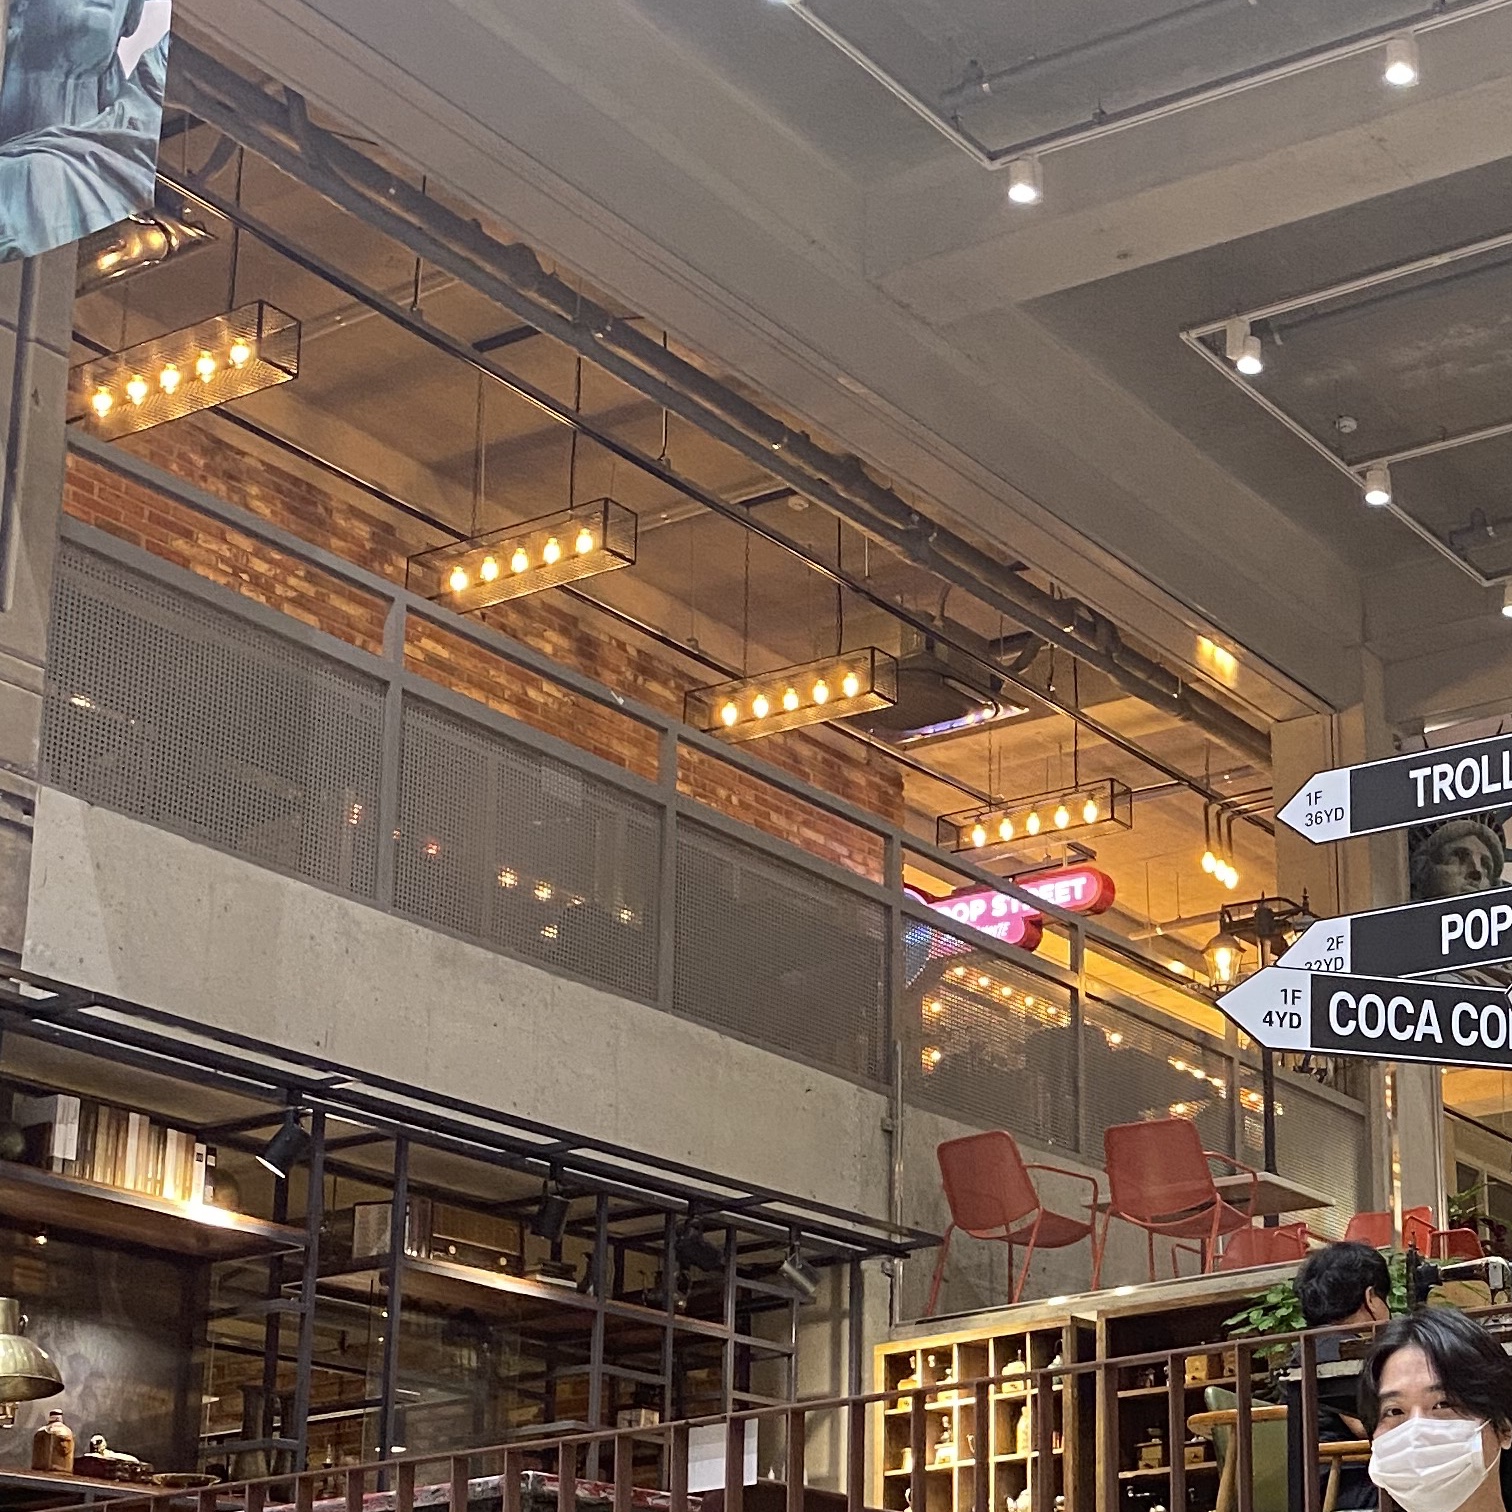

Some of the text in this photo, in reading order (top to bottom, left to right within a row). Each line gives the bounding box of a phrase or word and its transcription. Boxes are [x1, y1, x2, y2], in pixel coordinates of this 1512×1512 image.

[1305, 790, 1324, 807] 1F
[1304, 806, 1346, 828] 36YD
[1326, 934, 1346, 953] 2F
[1279, 986, 1303, 1005] 1F
[1261, 1009, 1303, 1031] 4YD
[1327, 990, 1443, 1045] COCA
